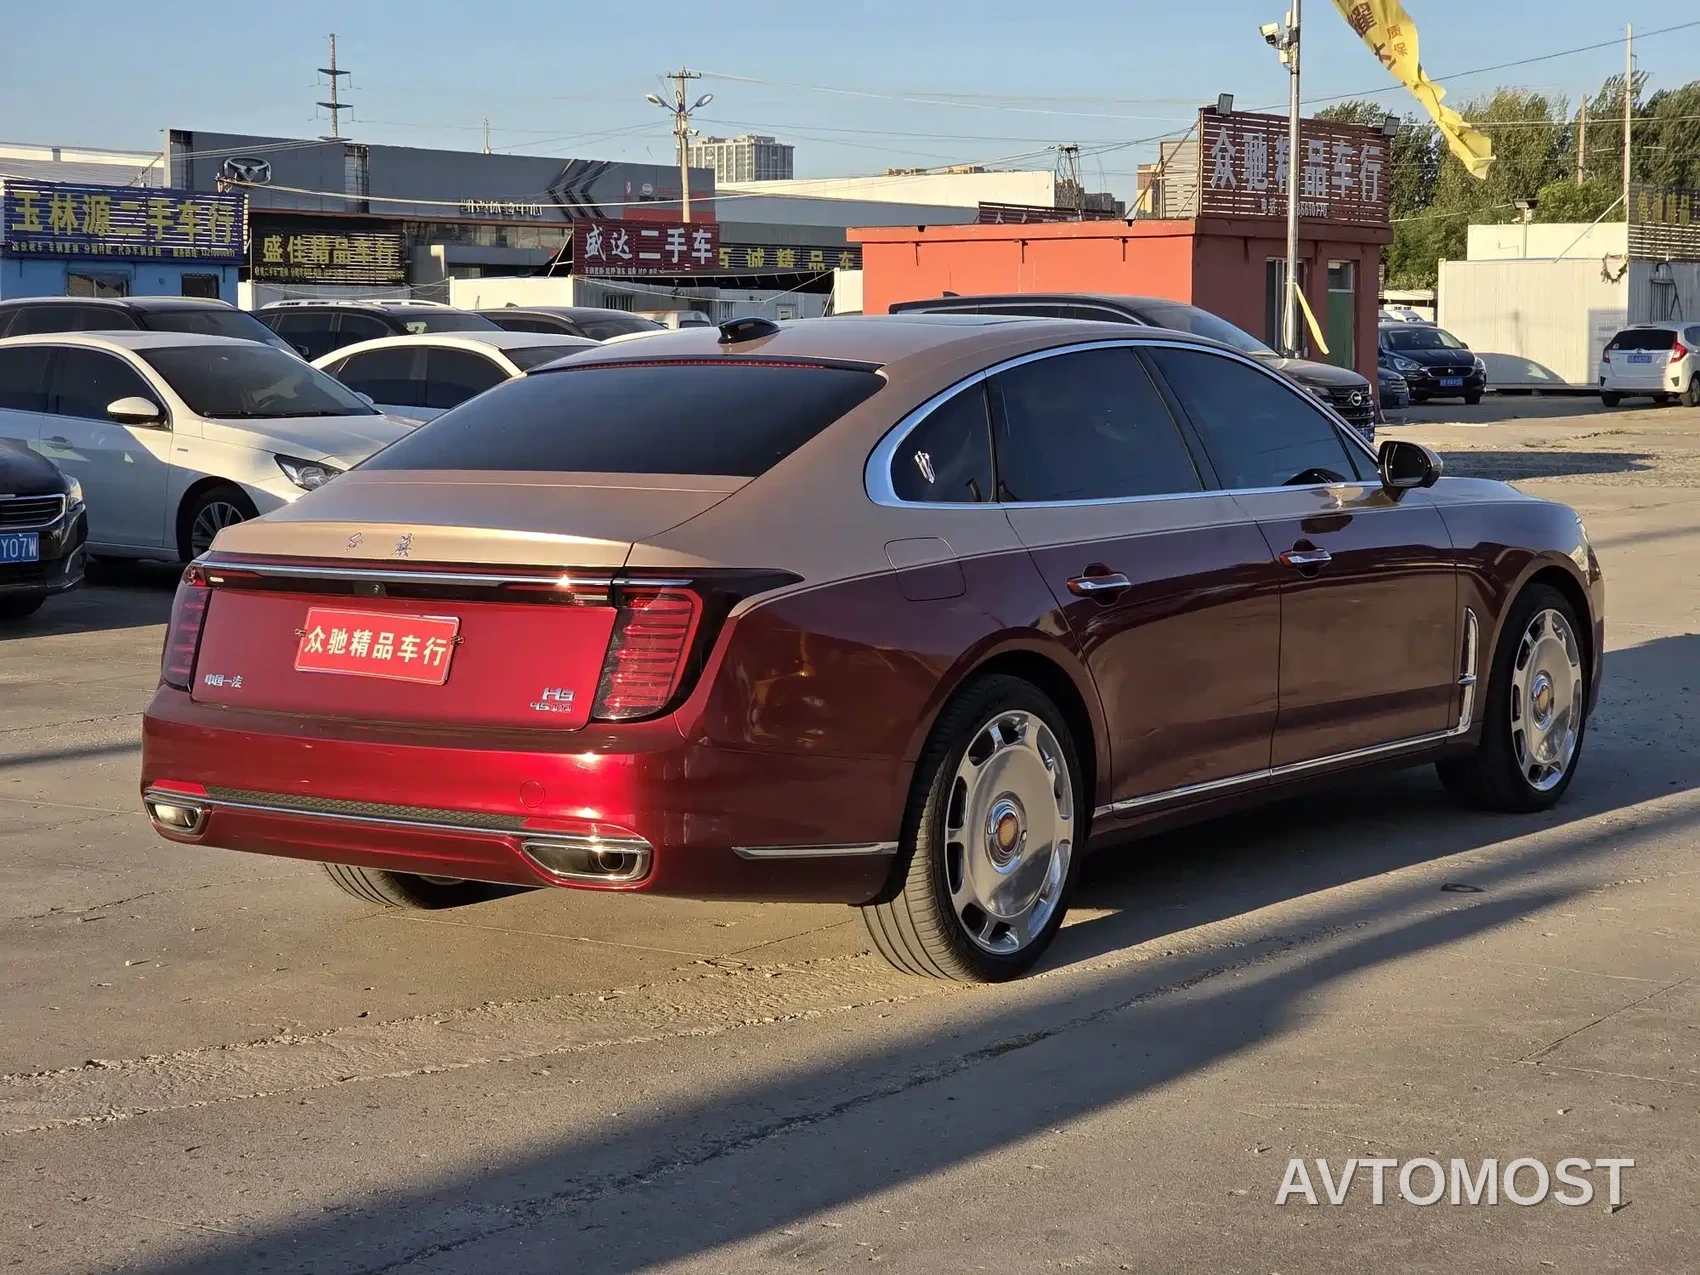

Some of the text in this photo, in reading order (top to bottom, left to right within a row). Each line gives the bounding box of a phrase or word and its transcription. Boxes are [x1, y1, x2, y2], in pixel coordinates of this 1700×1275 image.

[12, 191, 233, 243] 玉林源二手车行
[263, 235, 396, 265] 盛佳精品车行
[585, 223, 712, 264] 盛达二手车
[1, 537, 37, 559] Y07W
[304, 625, 447, 667] 众驰精品车行
